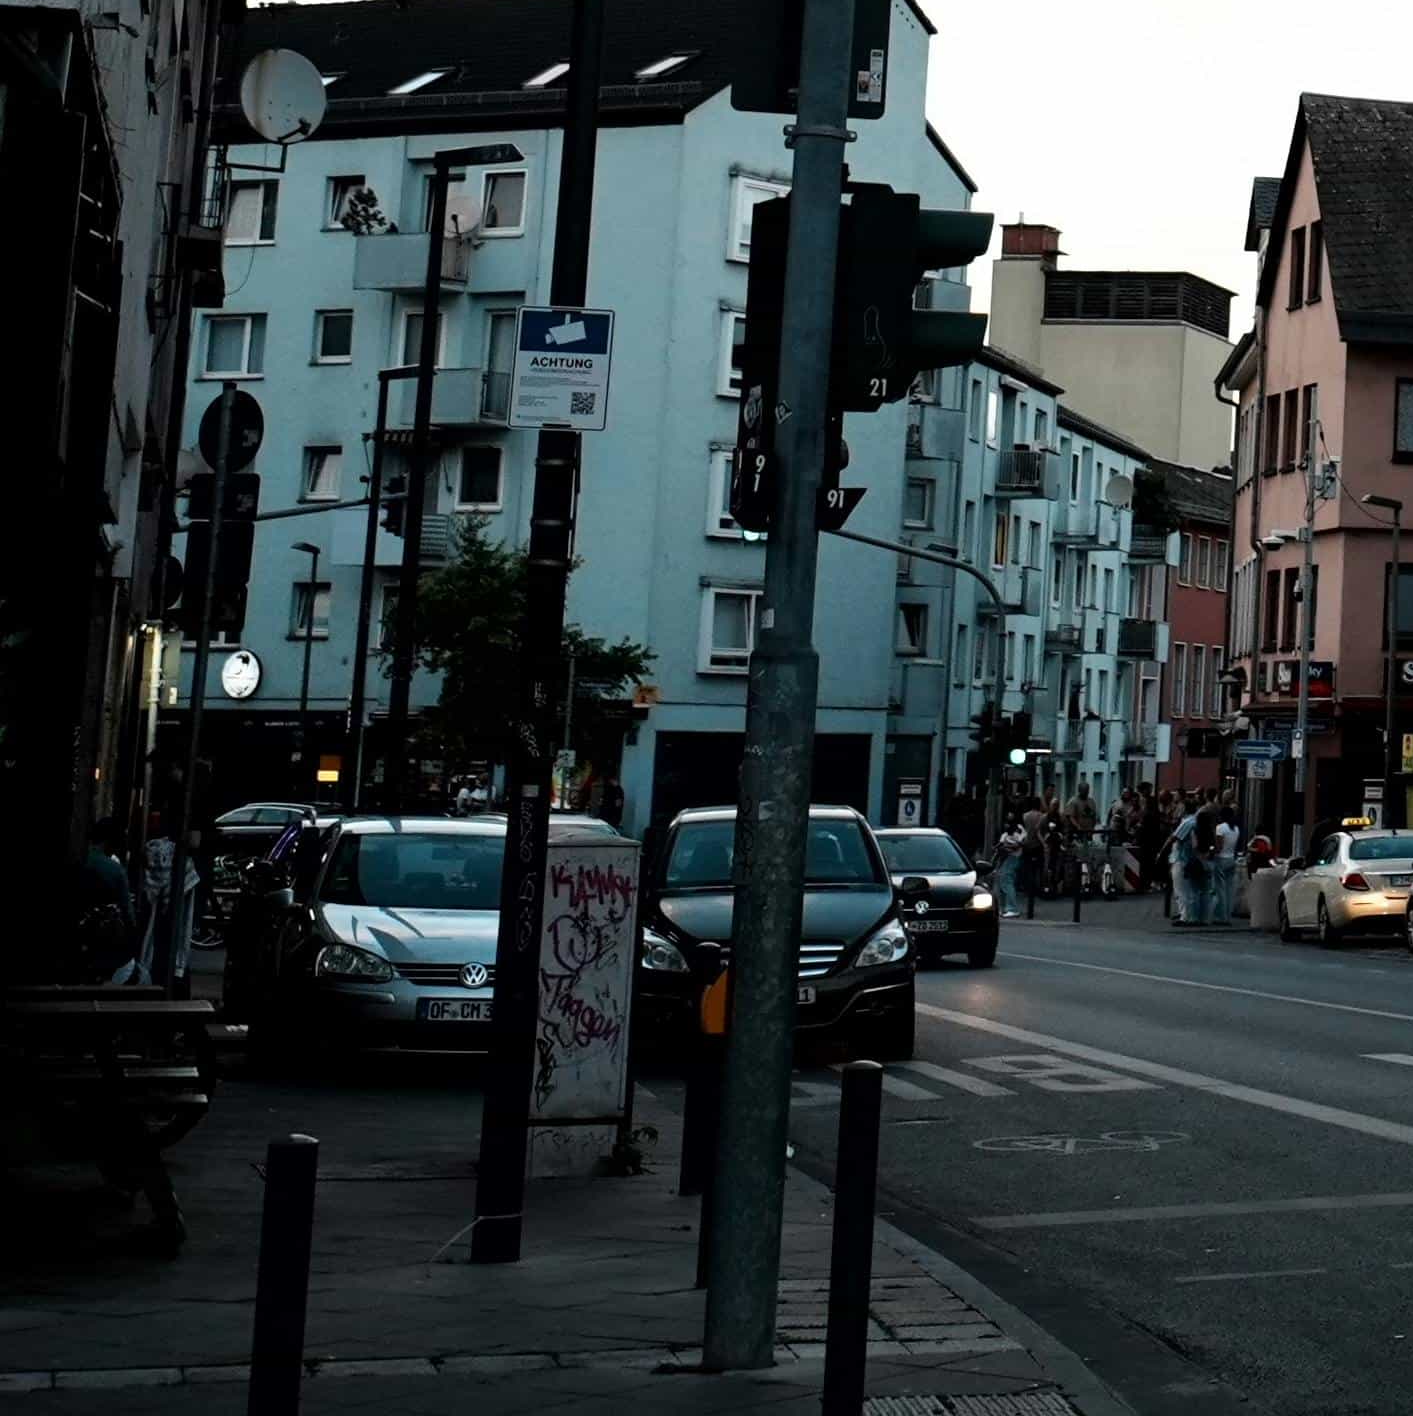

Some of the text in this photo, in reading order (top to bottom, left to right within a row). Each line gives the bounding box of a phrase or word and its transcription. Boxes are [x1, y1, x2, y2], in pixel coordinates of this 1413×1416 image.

[530, 357, 593, 369] ACHTUNG
[869, 378, 888, 398] 21
[826, 489, 846, 509] 91
